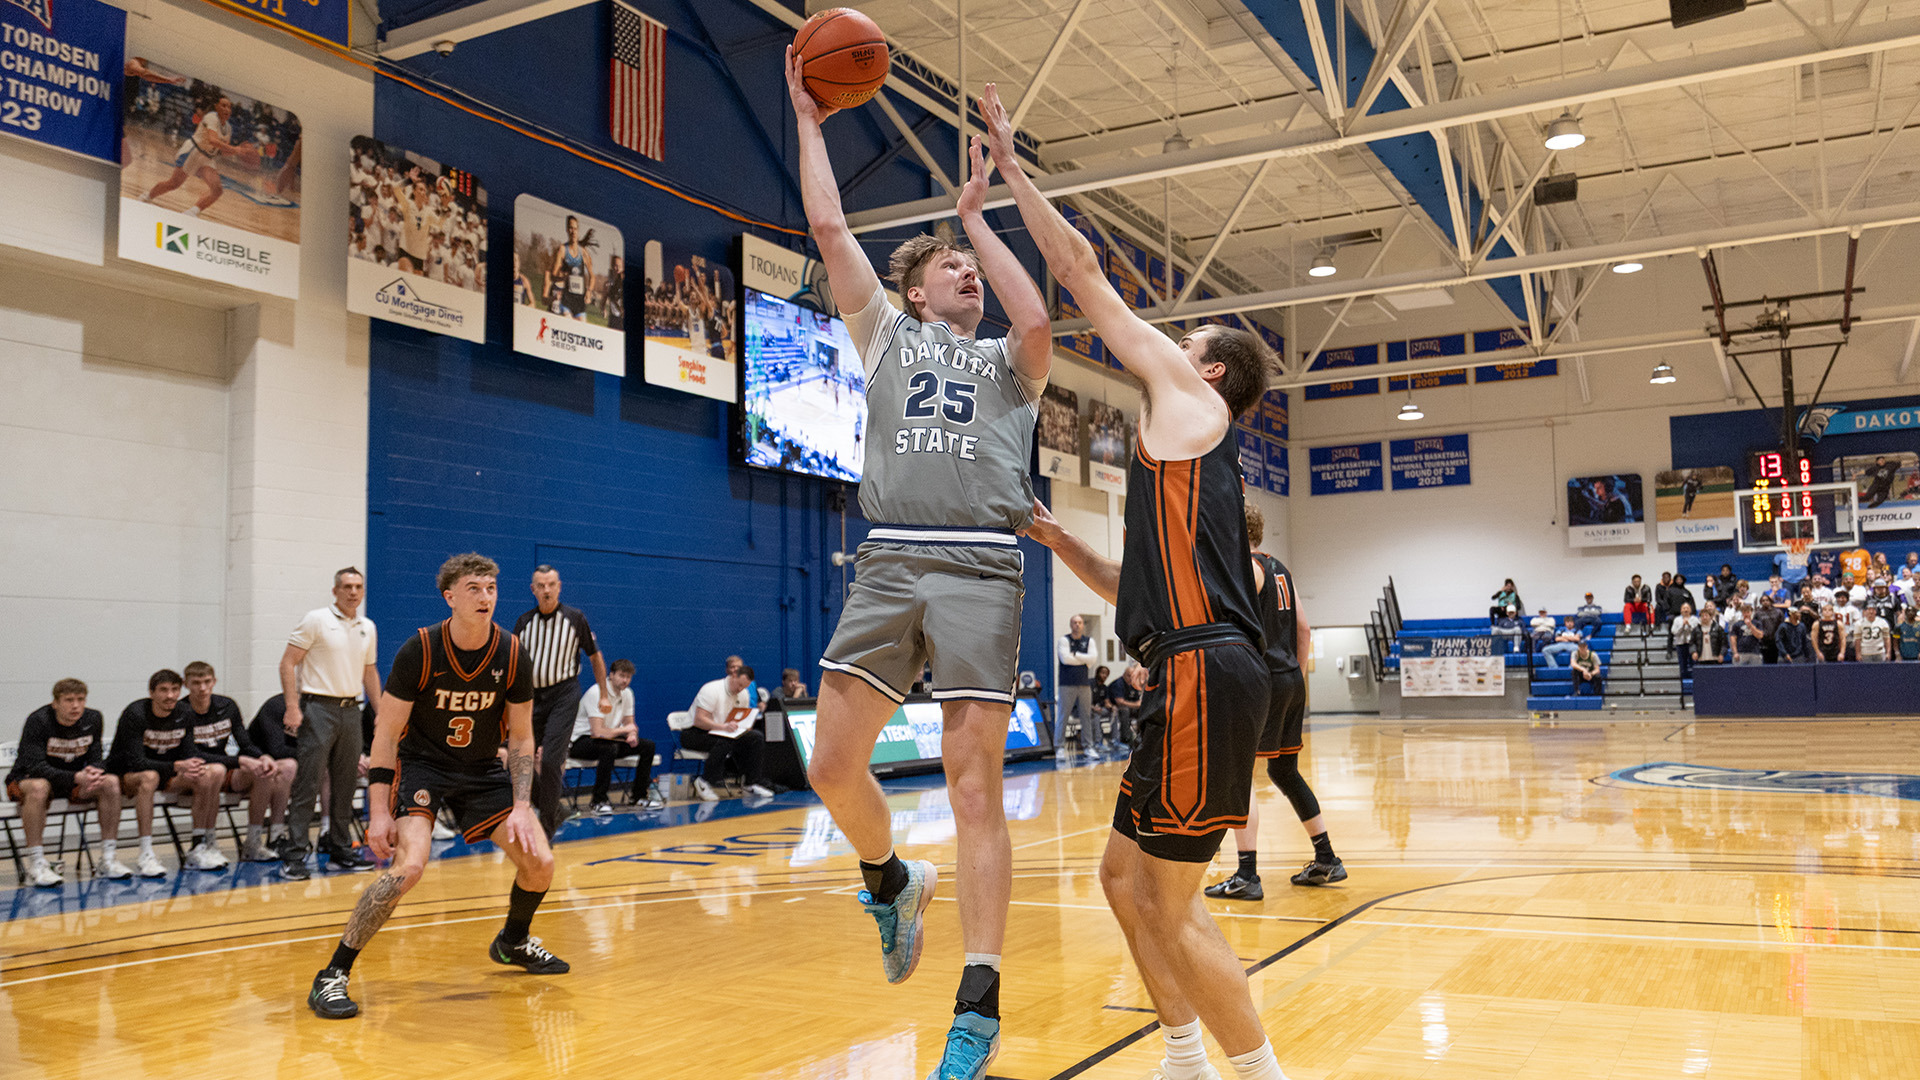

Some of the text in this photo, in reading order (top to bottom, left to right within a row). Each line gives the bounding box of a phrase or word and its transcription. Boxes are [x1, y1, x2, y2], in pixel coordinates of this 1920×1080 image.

[1, 22, 99, 71] TORDSEN
[0, 50, 111, 100] CHAMPION
[6, 77, 82, 116] THROW
[197, 234, 271, 265] KIBBLE
[196, 251, 270, 275] EQUIPMENT
[749, 254, 798, 285] TROJANS
[375, 291, 389, 304] CU
[391, 296, 436, 317] Mortgage
[438, 308, 463, 323] Direct
[551, 328, 603, 350] MUSTANG
[551, 340, 577, 352] SEEDS
[678, 355, 706, 373] Sunshine
[899, 340, 998, 382] DAKOTA
[903, 370, 977, 427] 25
[895, 427, 981, 461] STATE
[1340, 460, 1381, 470] BASKETBALL
[1391, 458, 1468, 471] NATIONAL TOURNAMENT
[1424, 450, 1466, 461] BASKETBALL
[1760, 453, 1782, 478] 13
[1321, 468, 1371, 481] ELITE EIGHT
[1404, 467, 1456, 479] ROUND OF 32
[1335, 478, 1358, 489] 2024
[1584, 527, 1630, 537] SANFORD
[1824, 632, 1834, 645] 3
[1863, 626, 1880, 640] 33
[1430, 648, 1492, 657] SPONSORS
[1431, 638, 1468, 649] THANK
[1470, 638, 1492, 648] YOU
[434, 688, 497, 711] TECH
[446, 716, 475, 748] 3
[885, 724, 912, 742] TECH
